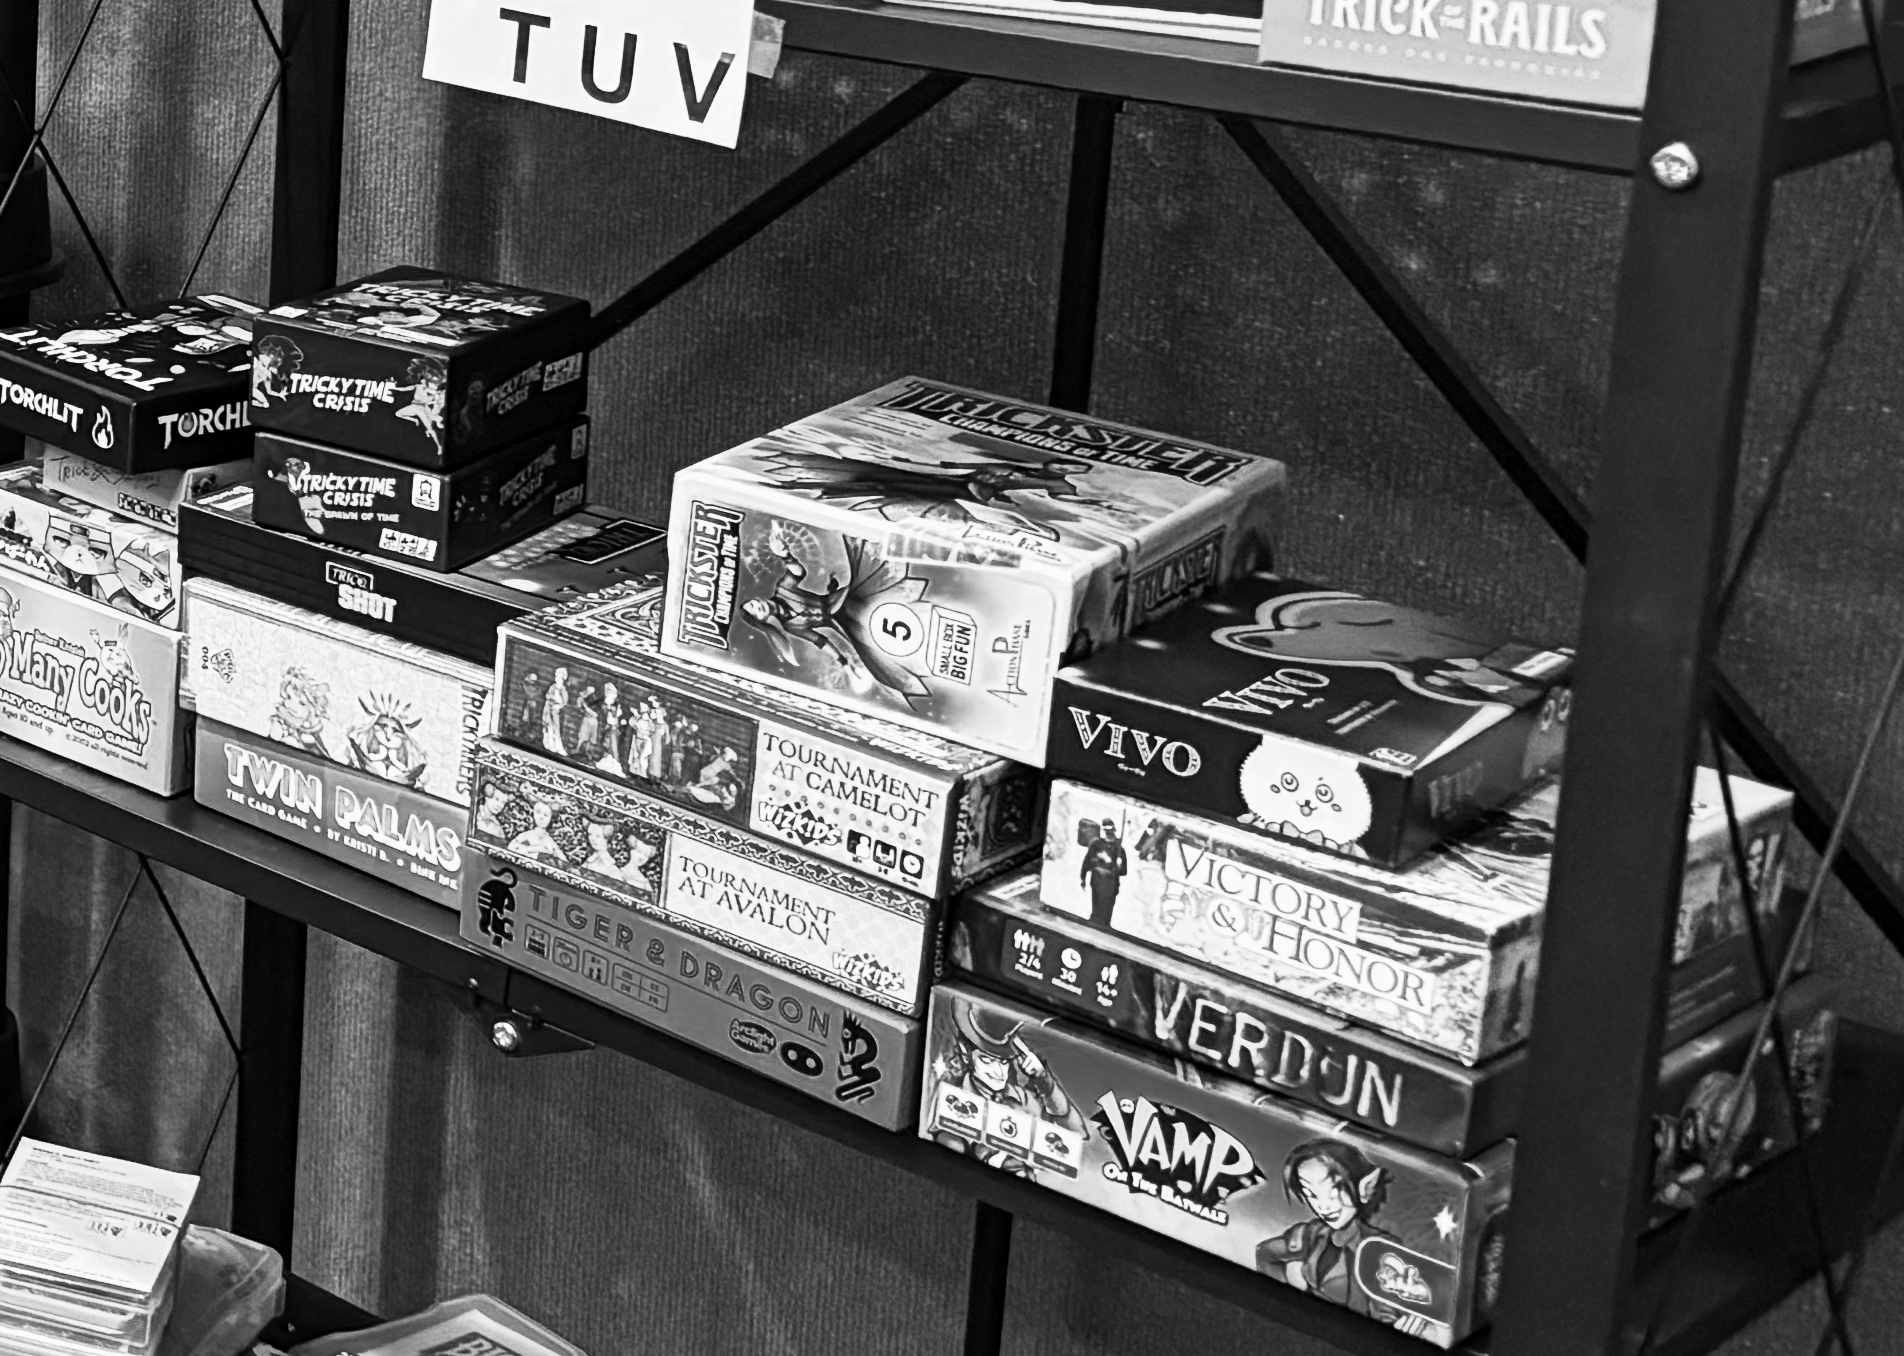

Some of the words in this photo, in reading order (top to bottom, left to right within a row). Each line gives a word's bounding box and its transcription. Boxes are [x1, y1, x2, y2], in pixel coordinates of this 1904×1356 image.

[289, 372, 356, 397] TRICKY
[356, 378, 395, 405] TIME
[312, 393, 371, 413] CRISIS
[300, 473, 360, 496] TRICKY
[359, 476, 397, 499] TIME
[322, 489, 375, 509] CRISIS
[336, 583, 398, 623] SHOT
[885, 613, 912, 644] 5
[8, 629, 76, 714] Many
[1202, 668, 1331, 715] VIVO
[71, 717, 105, 741] CARD
[1067, 705, 1202, 778] VIVO
[763, 732, 940, 810] TOURNAMENT
[771, 760, 802, 782] AT
[805, 772, 926, 828] CAMELOT
[223, 742, 323, 820] TWIN
[334, 785, 462, 873] PALMS
[225, 788, 246, 805] THE
[246, 796, 276, 817] CARD
[277, 807, 308, 830] GAME
[326, 828, 341, 842] BY
[678, 855, 836, 926] TOURNAMENT
[678, 876, 716, 900] AT
[716, 888, 830, 946] AVALON
[1174, 842, 1355, 936] VICTORY
[527, 884, 635, 953] TIGER
[679, 949, 831, 1040] DRAGON
[1059, 967, 1078, 984] 30
[1211, 903, 1238, 933] &
[1264, 913, 1427, 1008] HONOR
[1152, 971, 1404, 1127] VERDUN
[1094, 1089, 1254, 1195] VAMP
